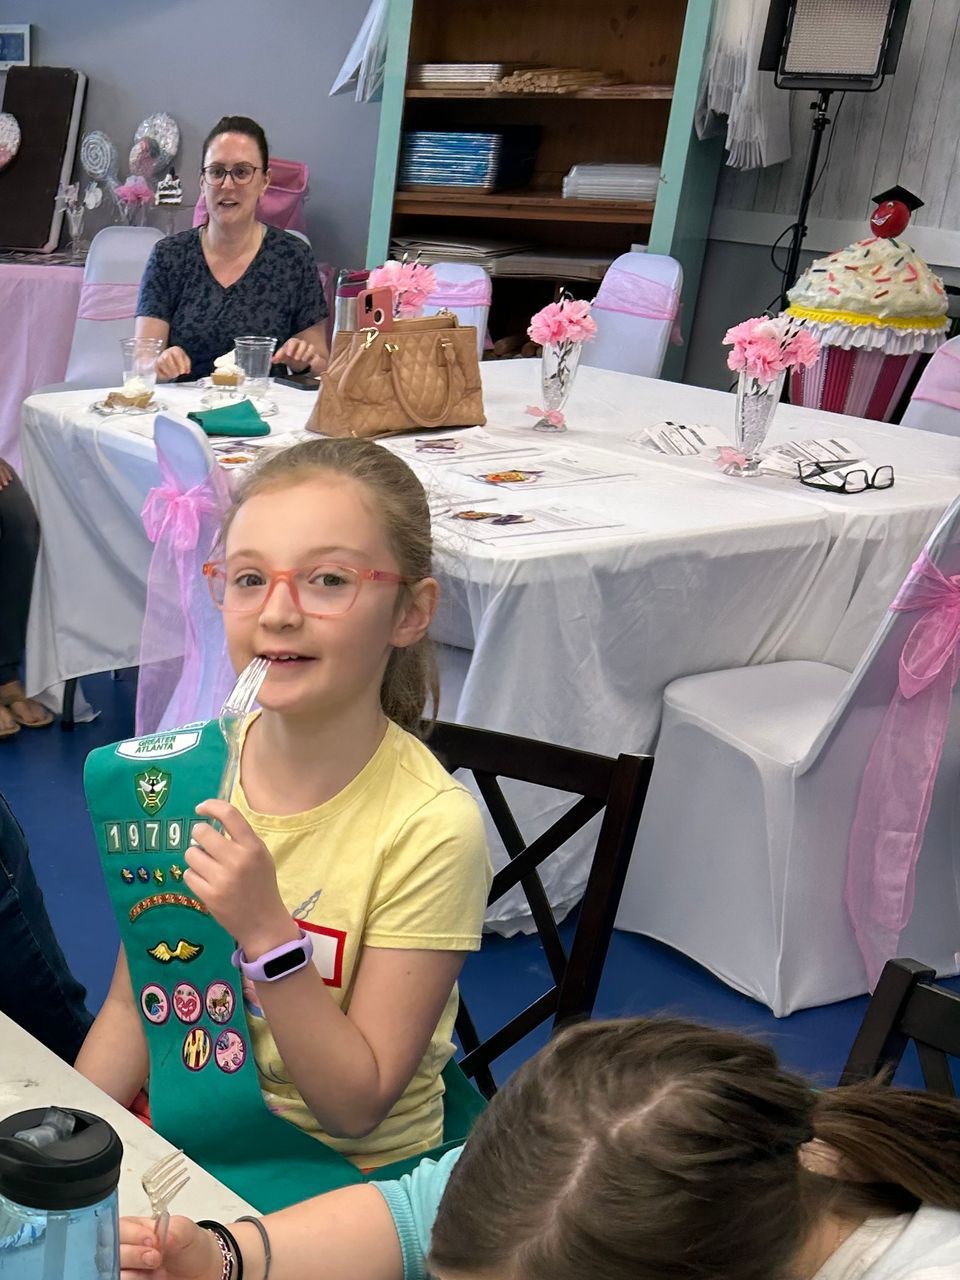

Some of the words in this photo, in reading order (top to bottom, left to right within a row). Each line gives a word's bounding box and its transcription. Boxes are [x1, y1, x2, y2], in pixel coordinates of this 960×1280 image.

[138, 735, 177, 747] GREATER
[135, 742, 174, 753] ATLANTA
[110, 822, 200, 849] 1979
